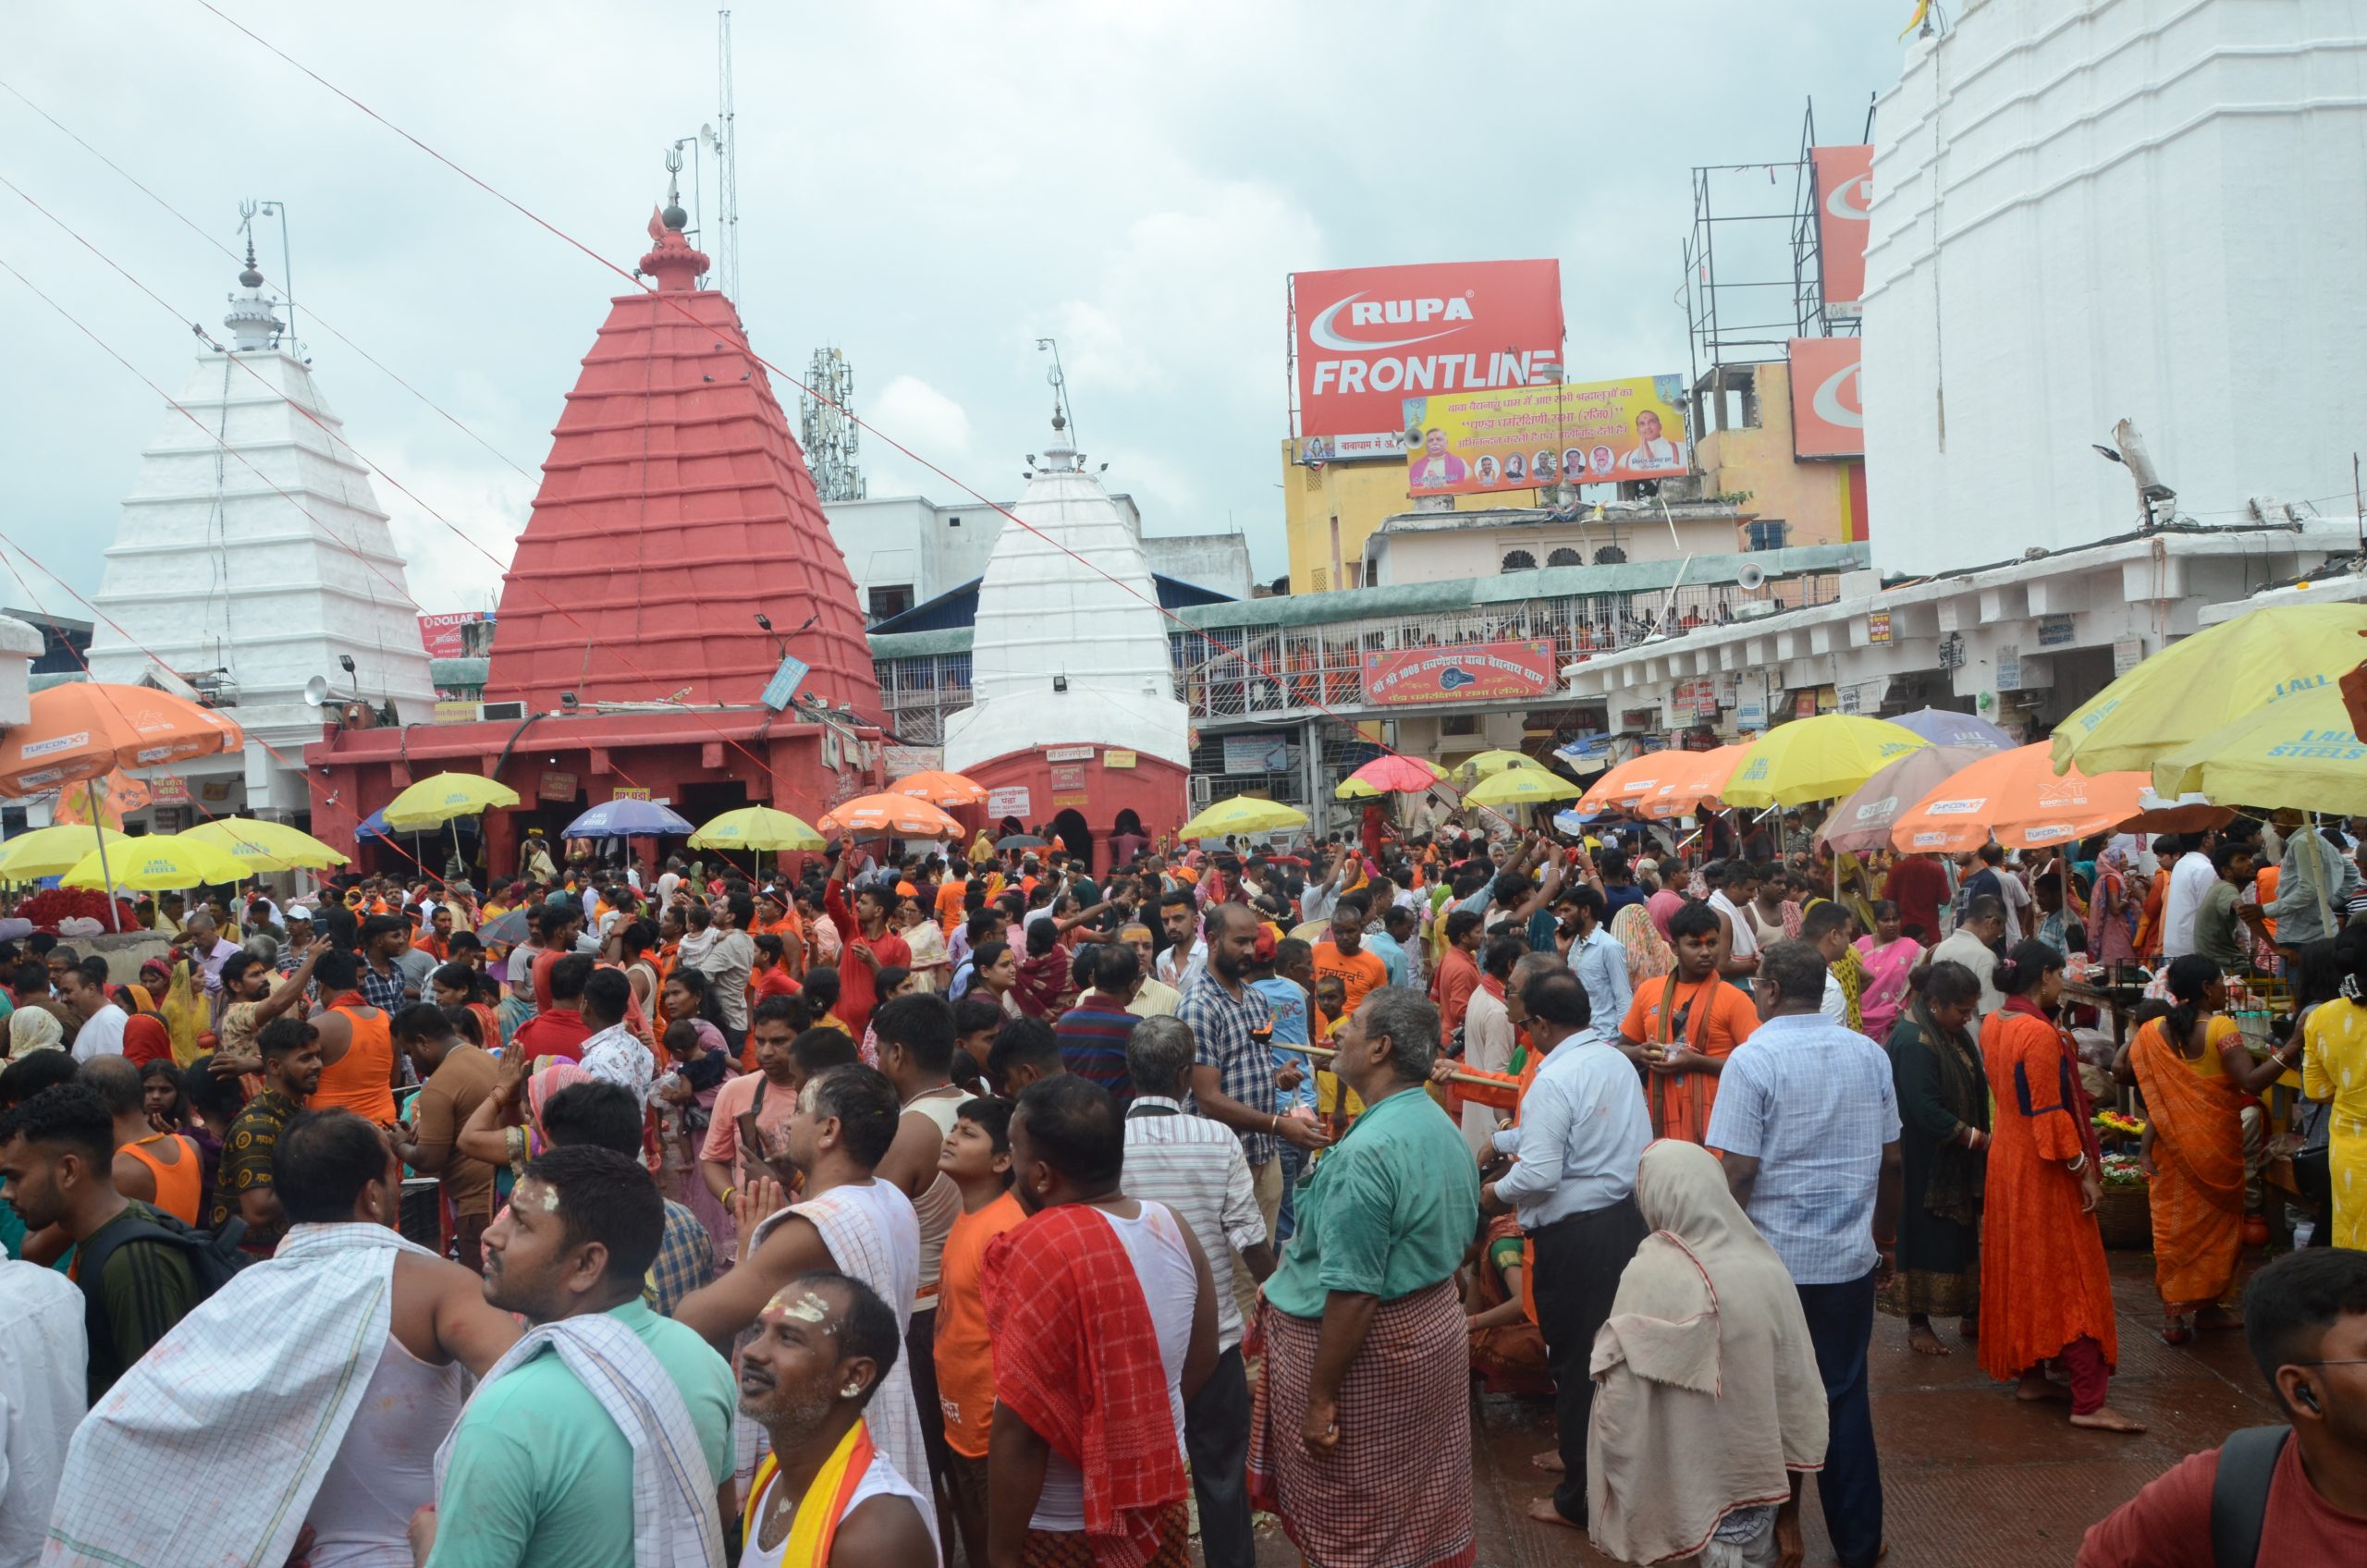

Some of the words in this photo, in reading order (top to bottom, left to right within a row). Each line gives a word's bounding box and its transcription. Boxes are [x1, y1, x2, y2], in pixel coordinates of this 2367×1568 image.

[1352, 297, 1474, 325] RUPA
[1312, 349, 1557, 395] FRONTLINE
[434, 613, 476, 627] DOLLAR
[1400, 663, 1420, 679] 1008
[2275, 674, 2334, 695] LALL
[1953, 731, 1986, 741] LALL
[24, 738, 68, 753] TUFCON
[2267, 745, 2367, 760] STEELS
[1933, 802, 1967, 811] TUFCON
[2027, 828, 2058, 839] TUFCON
